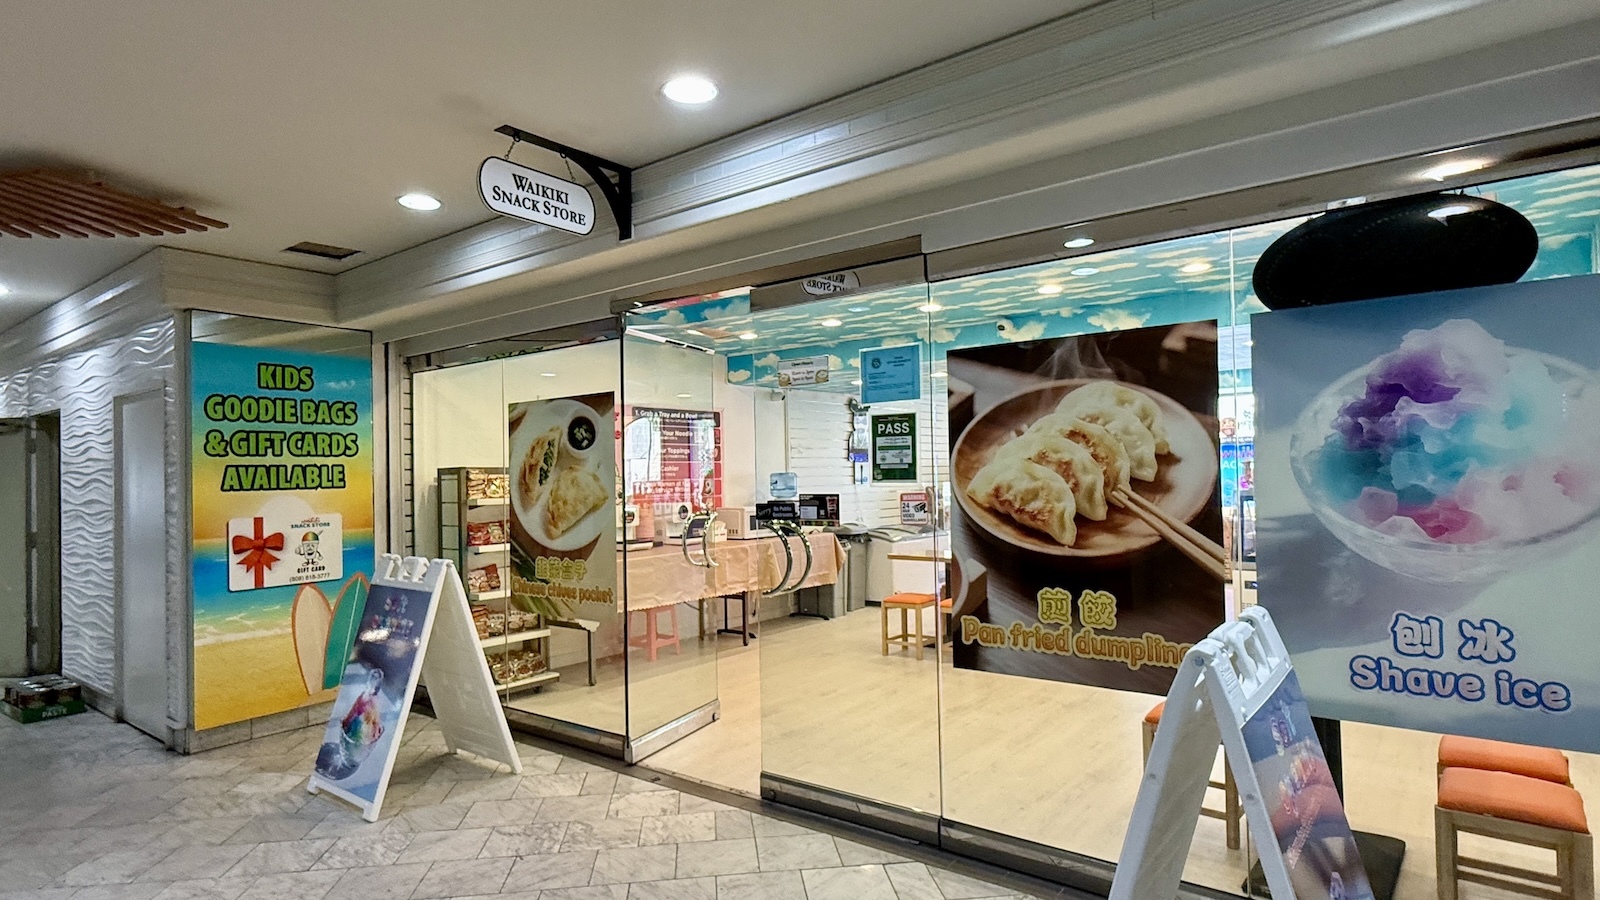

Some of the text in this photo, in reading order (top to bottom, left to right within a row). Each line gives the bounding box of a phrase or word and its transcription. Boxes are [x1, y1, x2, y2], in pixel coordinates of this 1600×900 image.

[512, 173, 569, 205] WAIKIKI
[492, 185, 586, 226] SNACK STORE
[258, 363, 314, 391] KIDS
[204, 394, 358, 426] GOODIE BAGS
[659, 411, 670, 419] Tray
[877, 422, 910, 434] PASS
[204, 429, 359, 458] & GIFT CARDS
[221, 465, 346, 492] AVAILABLE
[512, 577, 614, 605] Chinese chives pocket
[961, 616, 1005, 648] Pan
[1009, 621, 1071, 655] fried
[1350, 655, 1572, 712] Shave ice
